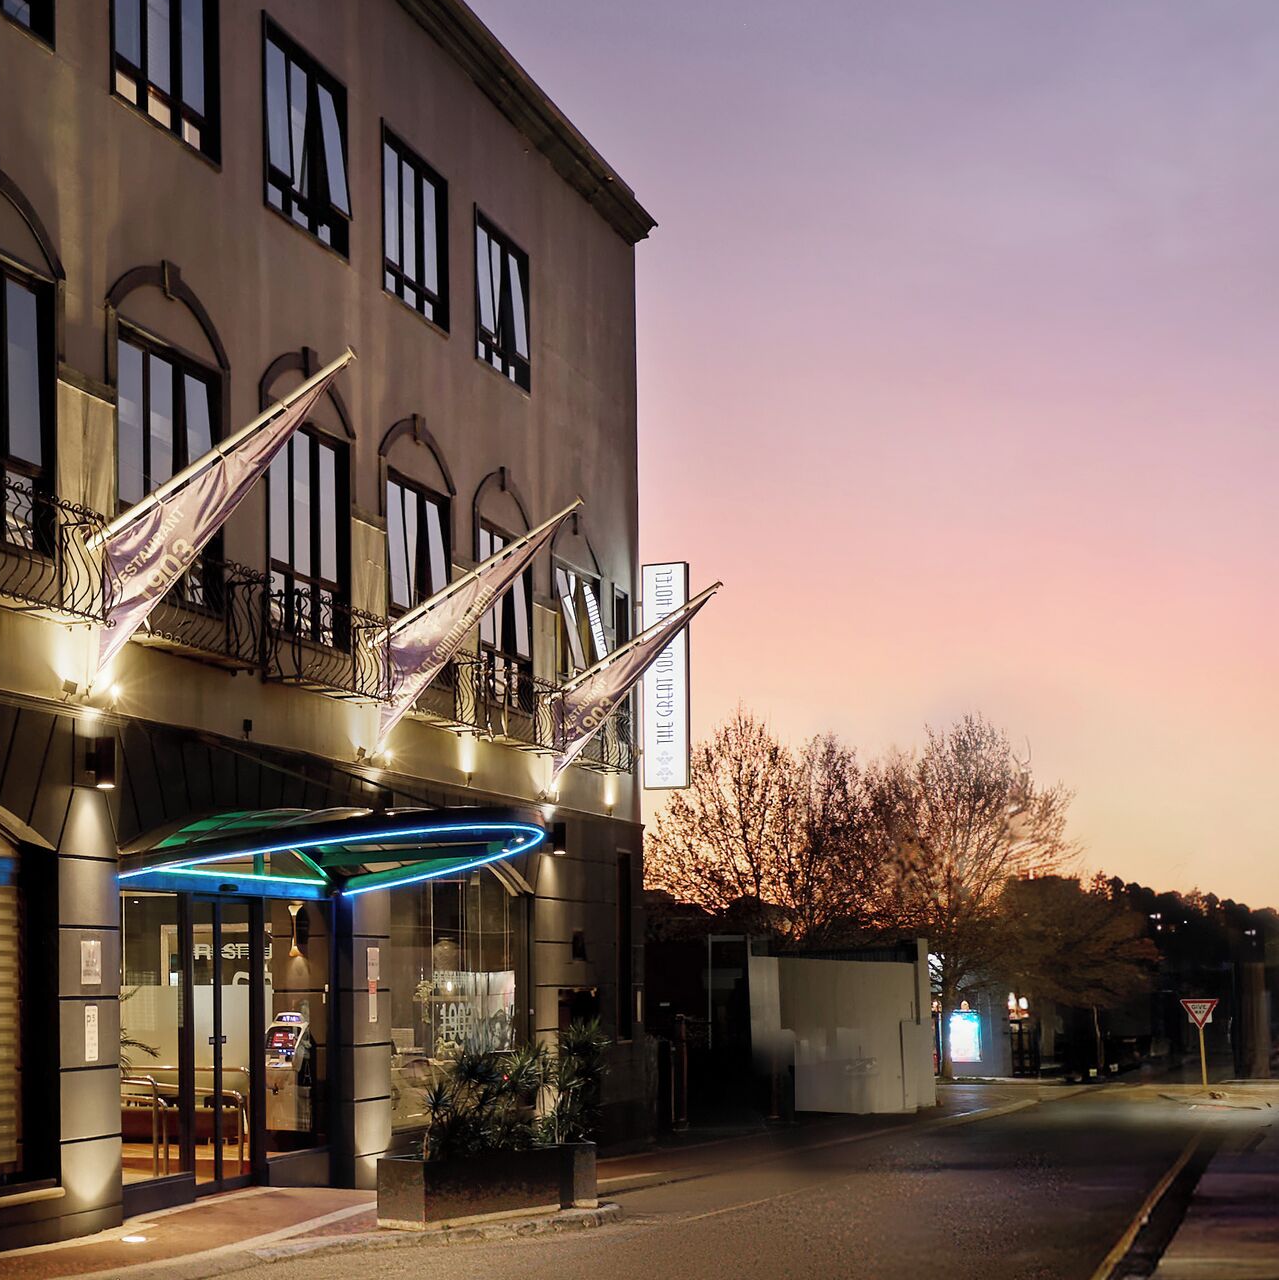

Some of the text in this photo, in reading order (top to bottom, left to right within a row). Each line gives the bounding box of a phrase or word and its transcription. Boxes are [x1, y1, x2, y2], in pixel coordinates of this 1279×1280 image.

[112, 505, 185, 594] RESTAURANT
[134, 538, 195, 600] 1903
[655, 568, 673, 606] HOTEL
[655, 677, 674, 718] GREAT
[656, 721, 674, 745] THE
